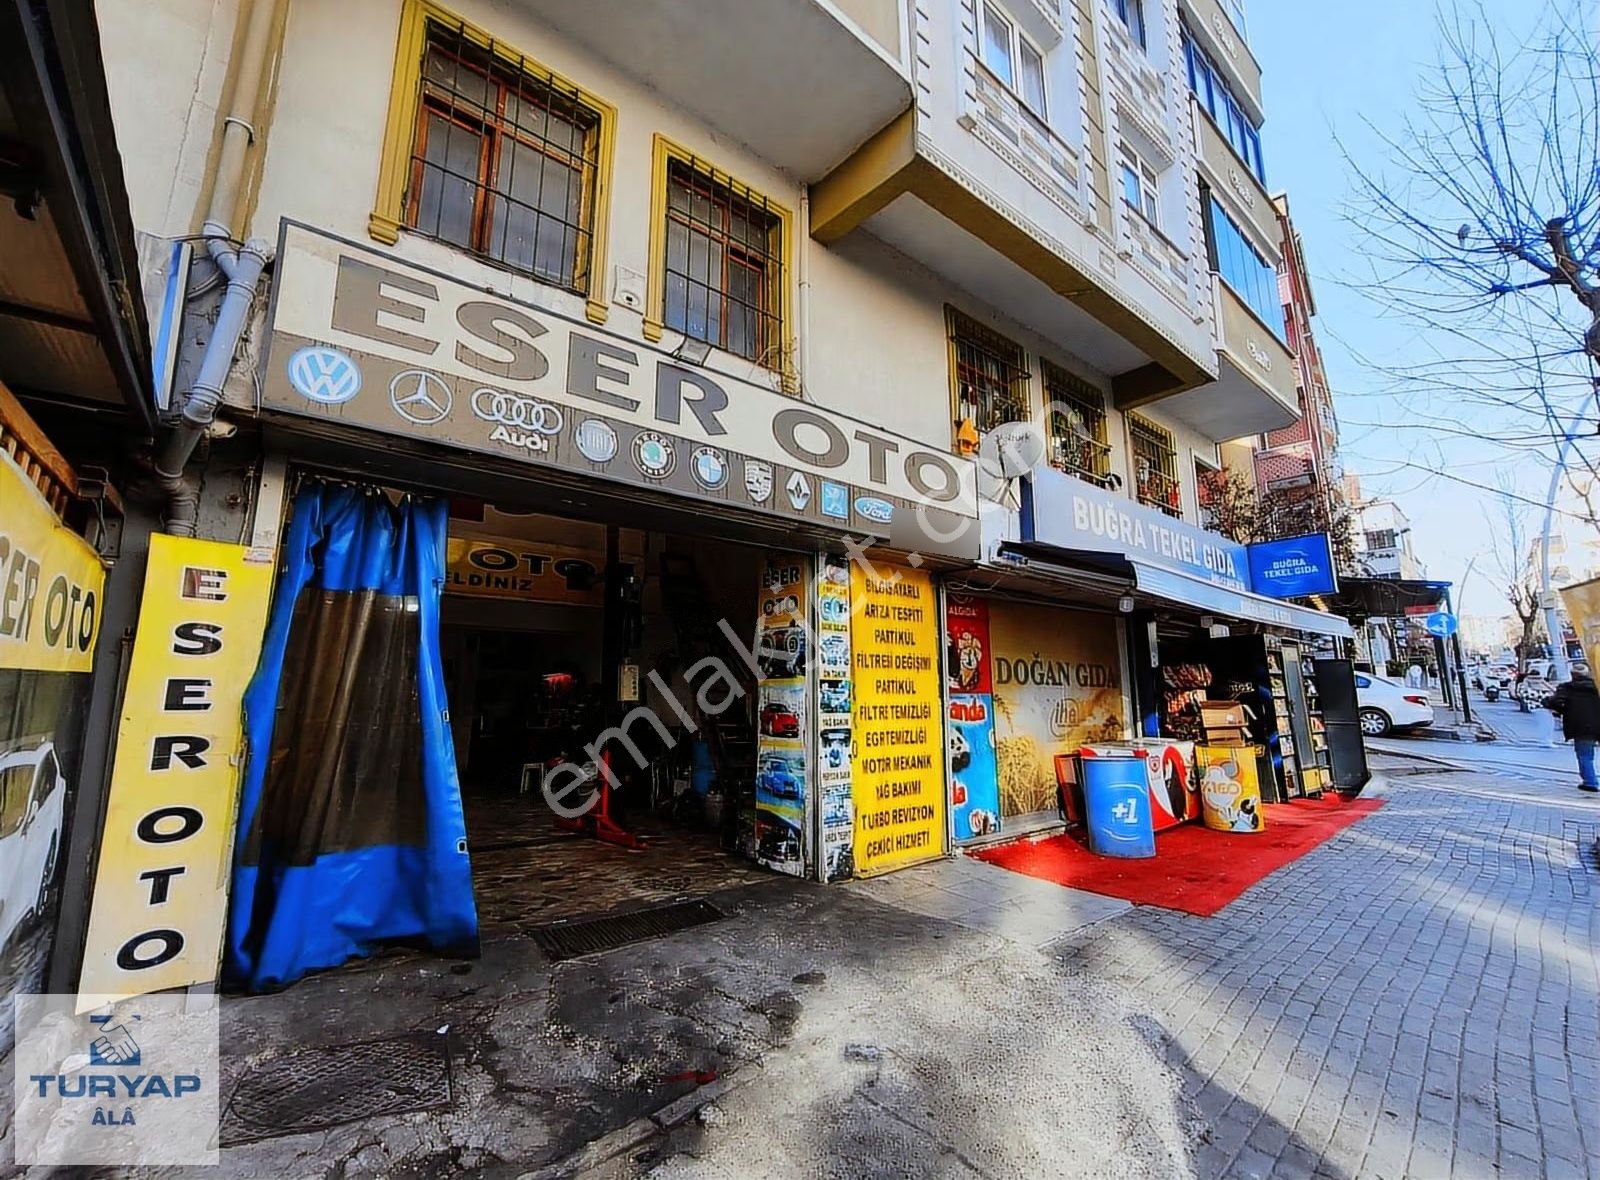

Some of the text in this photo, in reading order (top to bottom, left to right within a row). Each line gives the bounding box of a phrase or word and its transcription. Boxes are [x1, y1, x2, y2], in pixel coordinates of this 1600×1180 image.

[331, 254, 961, 502] ESER OTO
[489, 425, 549, 452] Audi
[1072, 495, 1236, 578] BUĞRA TEKEL GIDA
[1264, 565, 1319, 578] TEKEL GIDA
[45, 575, 95, 652] OTO
[864, 603, 890, 619] ARIZA
[995, 651, 1118, 688] DOĞAN GIDA
[950, 697, 985, 721] anda
[116, 566, 228, 972] ESER OTO
[861, 810, 890, 831] TURBO
[1111, 797, 1138, 824] +1
